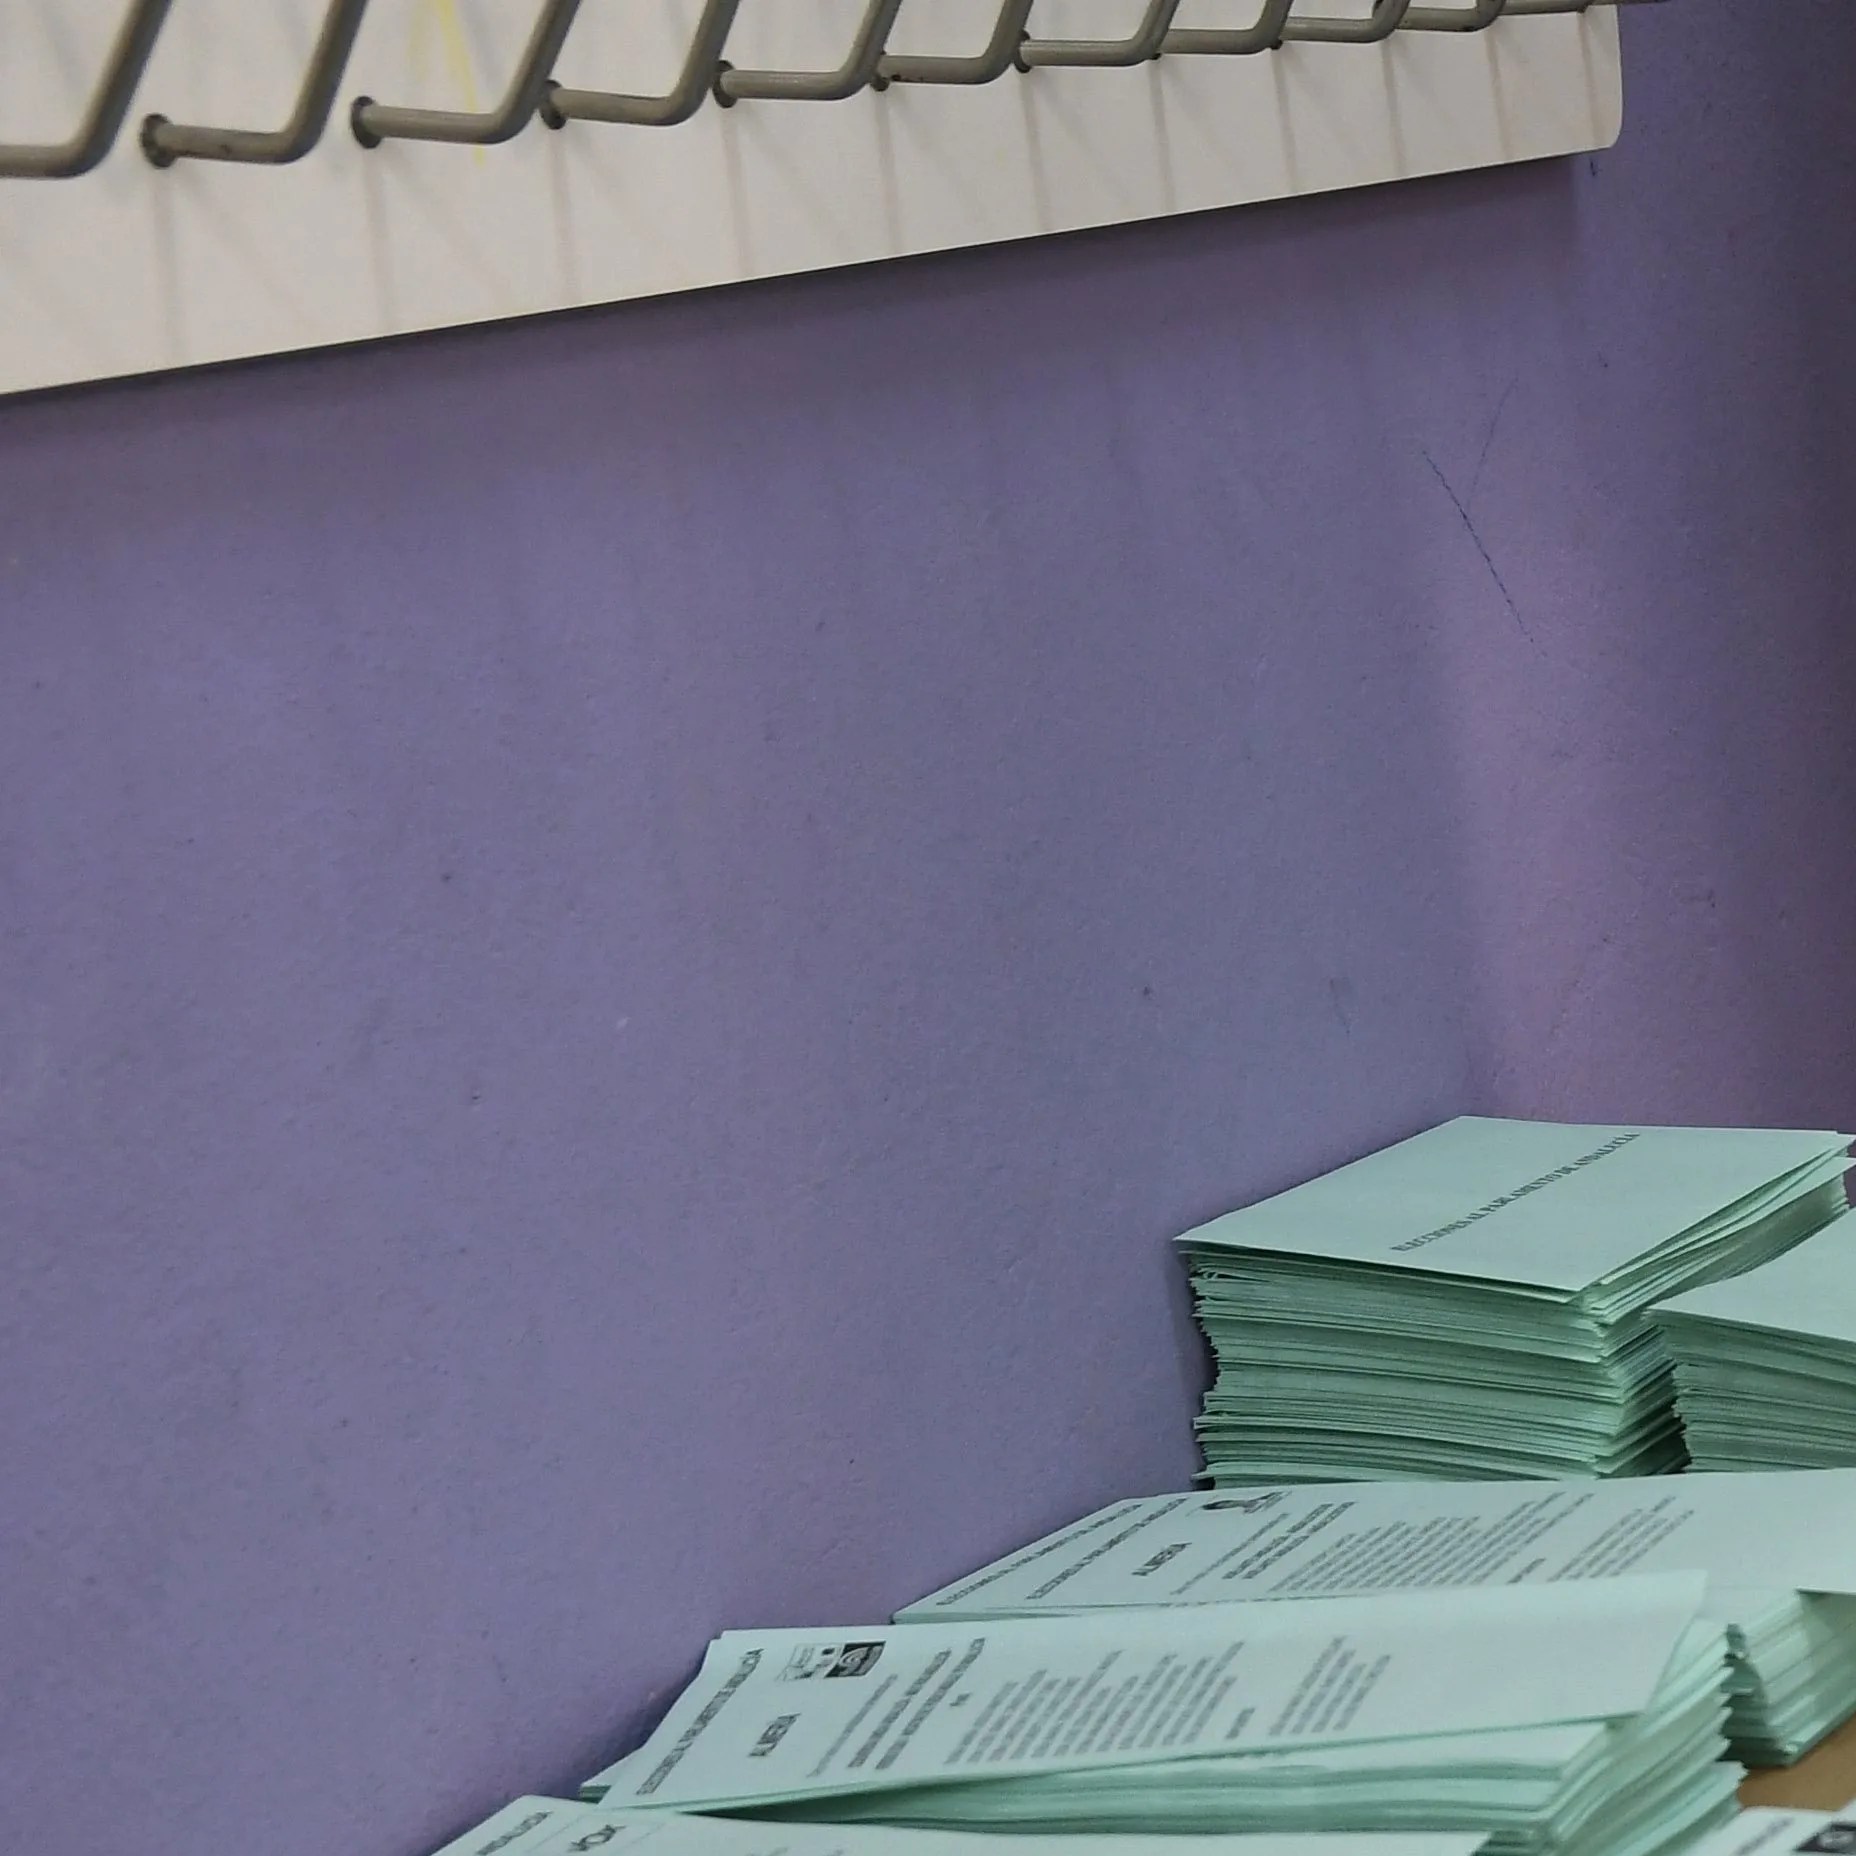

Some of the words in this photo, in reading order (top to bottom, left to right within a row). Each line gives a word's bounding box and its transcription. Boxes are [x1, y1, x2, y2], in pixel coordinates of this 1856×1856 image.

[1468, 1209, 1490, 1220] AL
[1479, 1171, 1562, 1212] PARLAMENTO
[1554, 1165, 1580, 1176] DE
[567, 1825, 627, 1851] VOX
